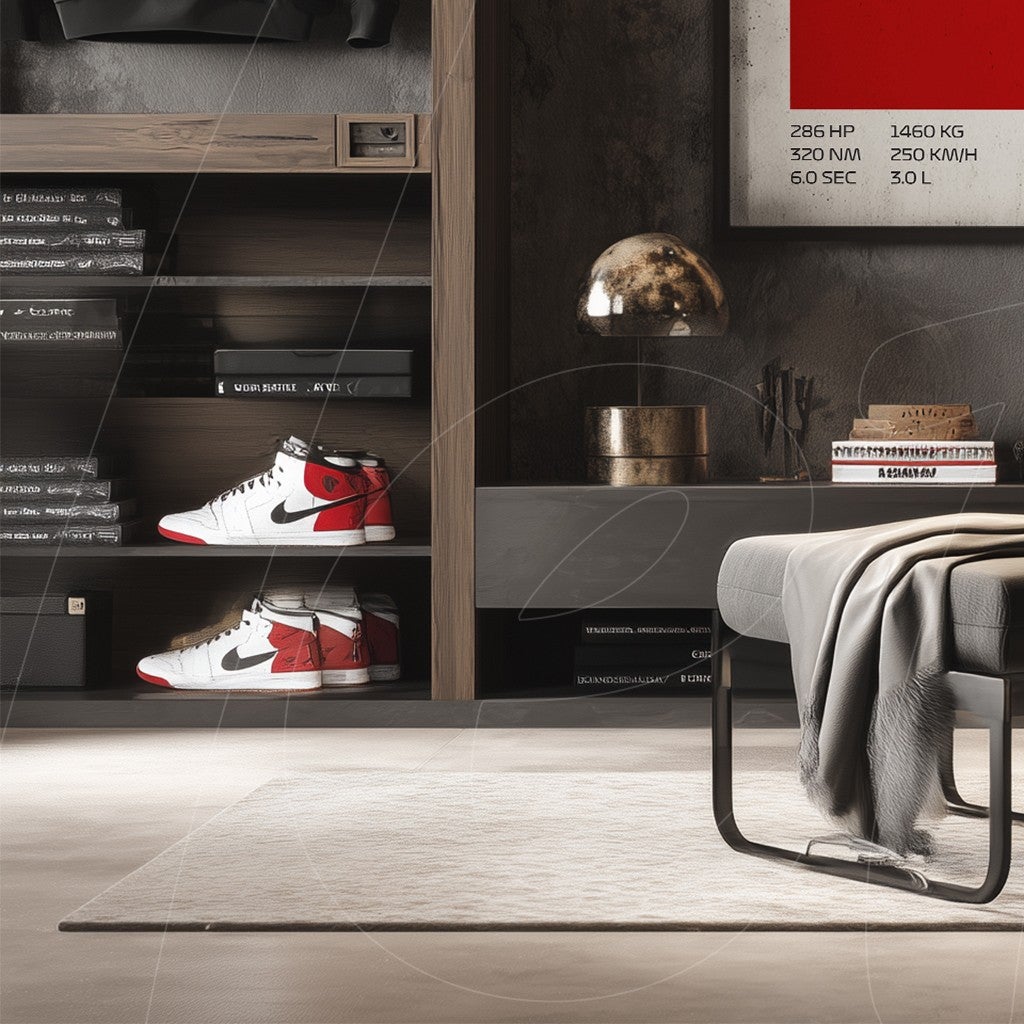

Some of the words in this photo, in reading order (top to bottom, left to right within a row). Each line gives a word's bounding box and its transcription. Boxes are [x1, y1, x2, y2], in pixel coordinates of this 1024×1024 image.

[790, 124, 825, 138] 286
[829, 124, 855, 138] HP
[890, 124, 936, 139] 1460
[940, 124, 964, 139] KG
[790, 147, 825, 162] 320
[829, 147, 861, 162] NM
[890, 147, 925, 162] 250
[930, 147, 978, 163] KM/H
[790, 170, 817, 185] 6.0
[821, 170, 857, 185] SEC
[890, 170, 917, 185] 3.0
[921, 170, 932, 185] L
